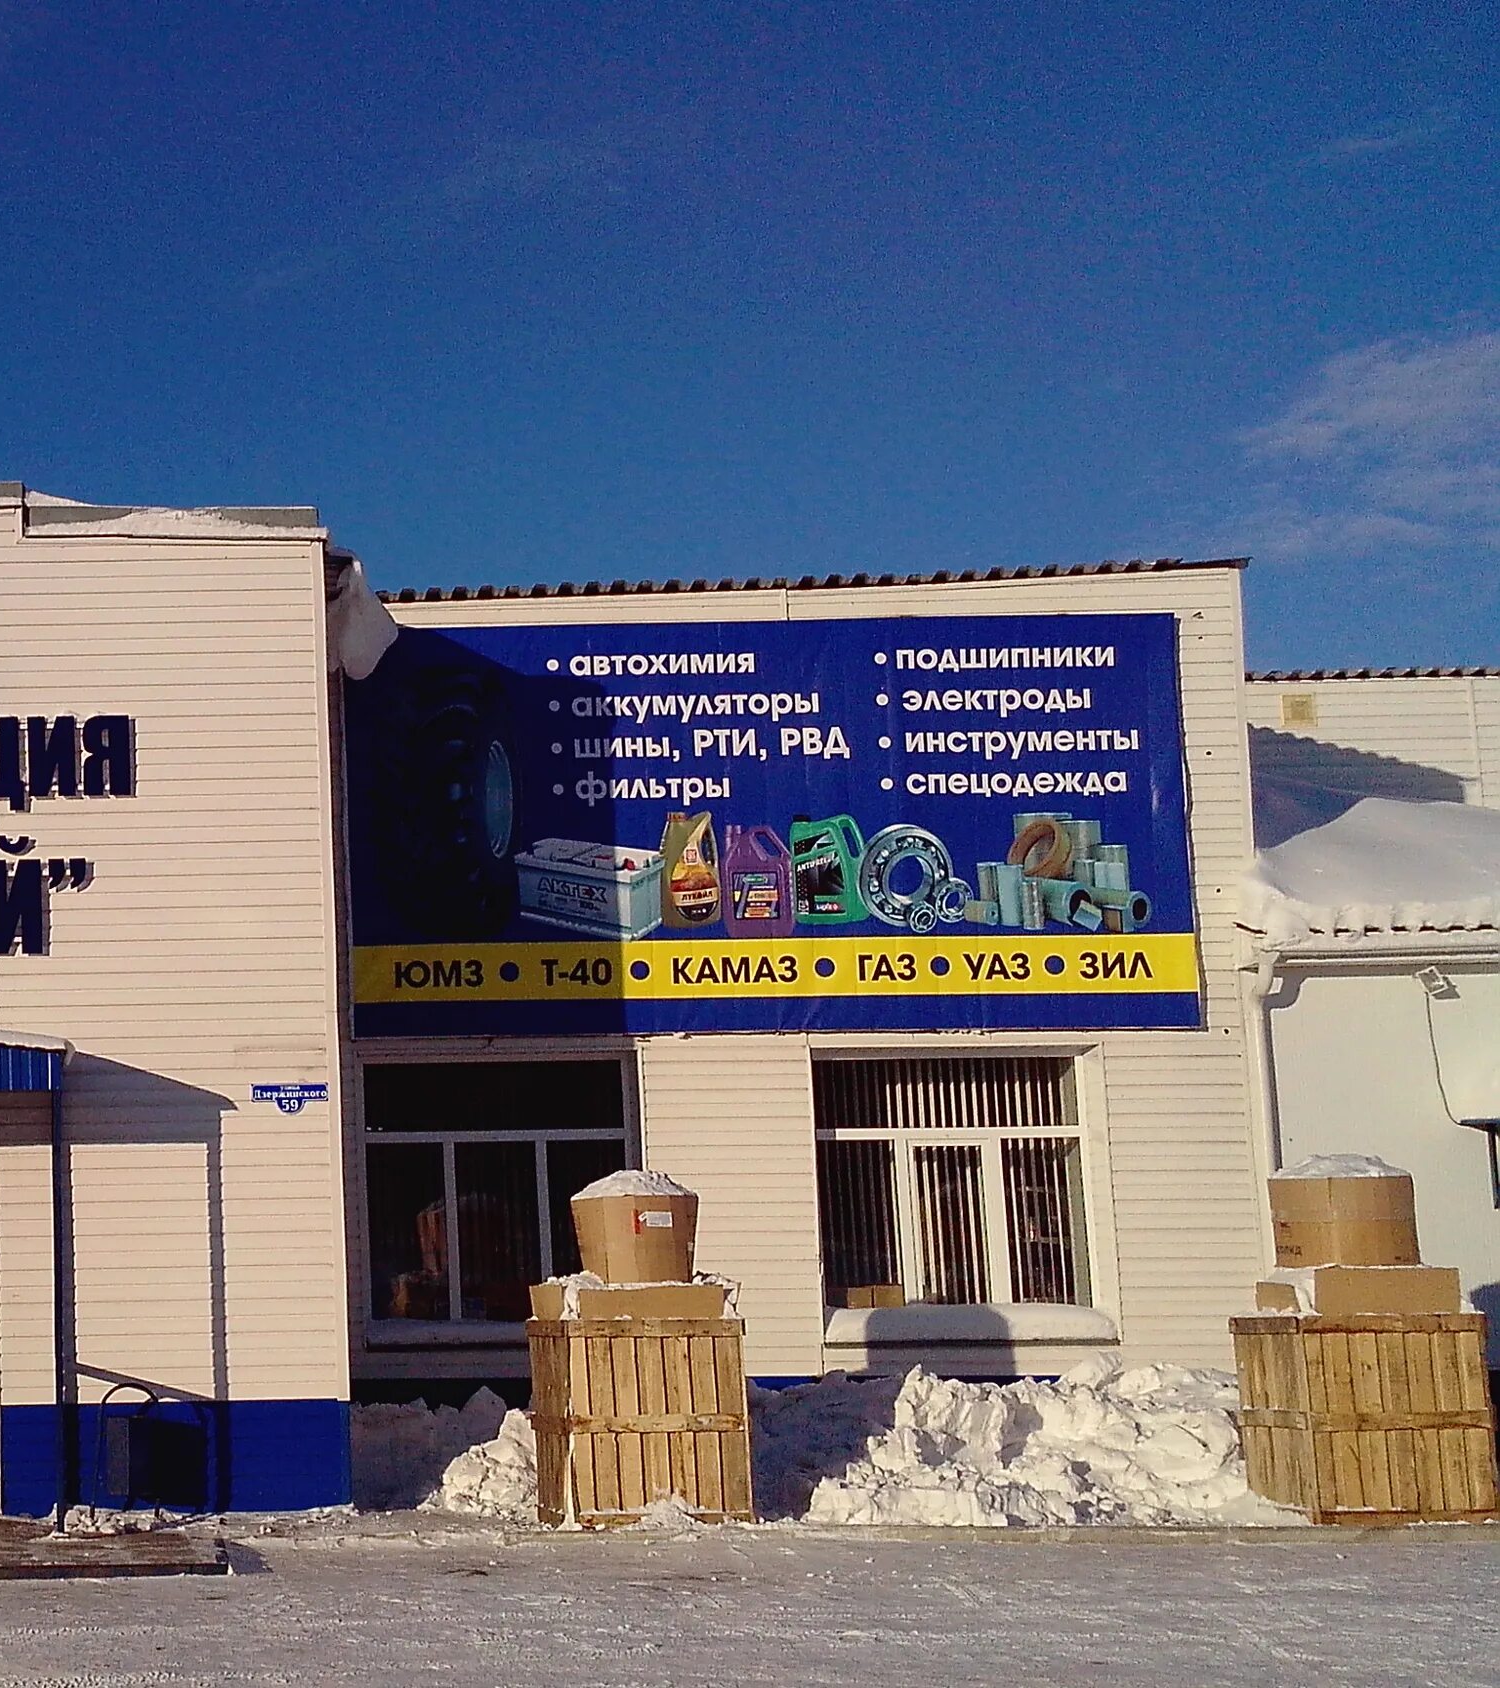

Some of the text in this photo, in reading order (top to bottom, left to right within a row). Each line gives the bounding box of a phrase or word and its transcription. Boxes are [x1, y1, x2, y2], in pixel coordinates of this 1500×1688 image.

[568, 652, 756, 677] автохимия
[895, 645, 1116, 673] подшипники
[571, 691, 821, 724] аккумуляторы
[901, 687, 1093, 718] электроды
[573, 726, 851, 762] шины, РТИ, РВД
[904, 728, 1140, 760] инструменты
[575, 770, 731, 807] фильтры
[905, 770, 1129, 798] спецодежда
[537, 876, 608, 903] AKTEX
[393, 950, 1154, 989] ЮМЗ Т-40 КАМАЗ ГАЗ УАЗ ЗИЛ
[254, 1090, 328, 1100] Дзержинского
[281, 1099, 299, 1111] 59
